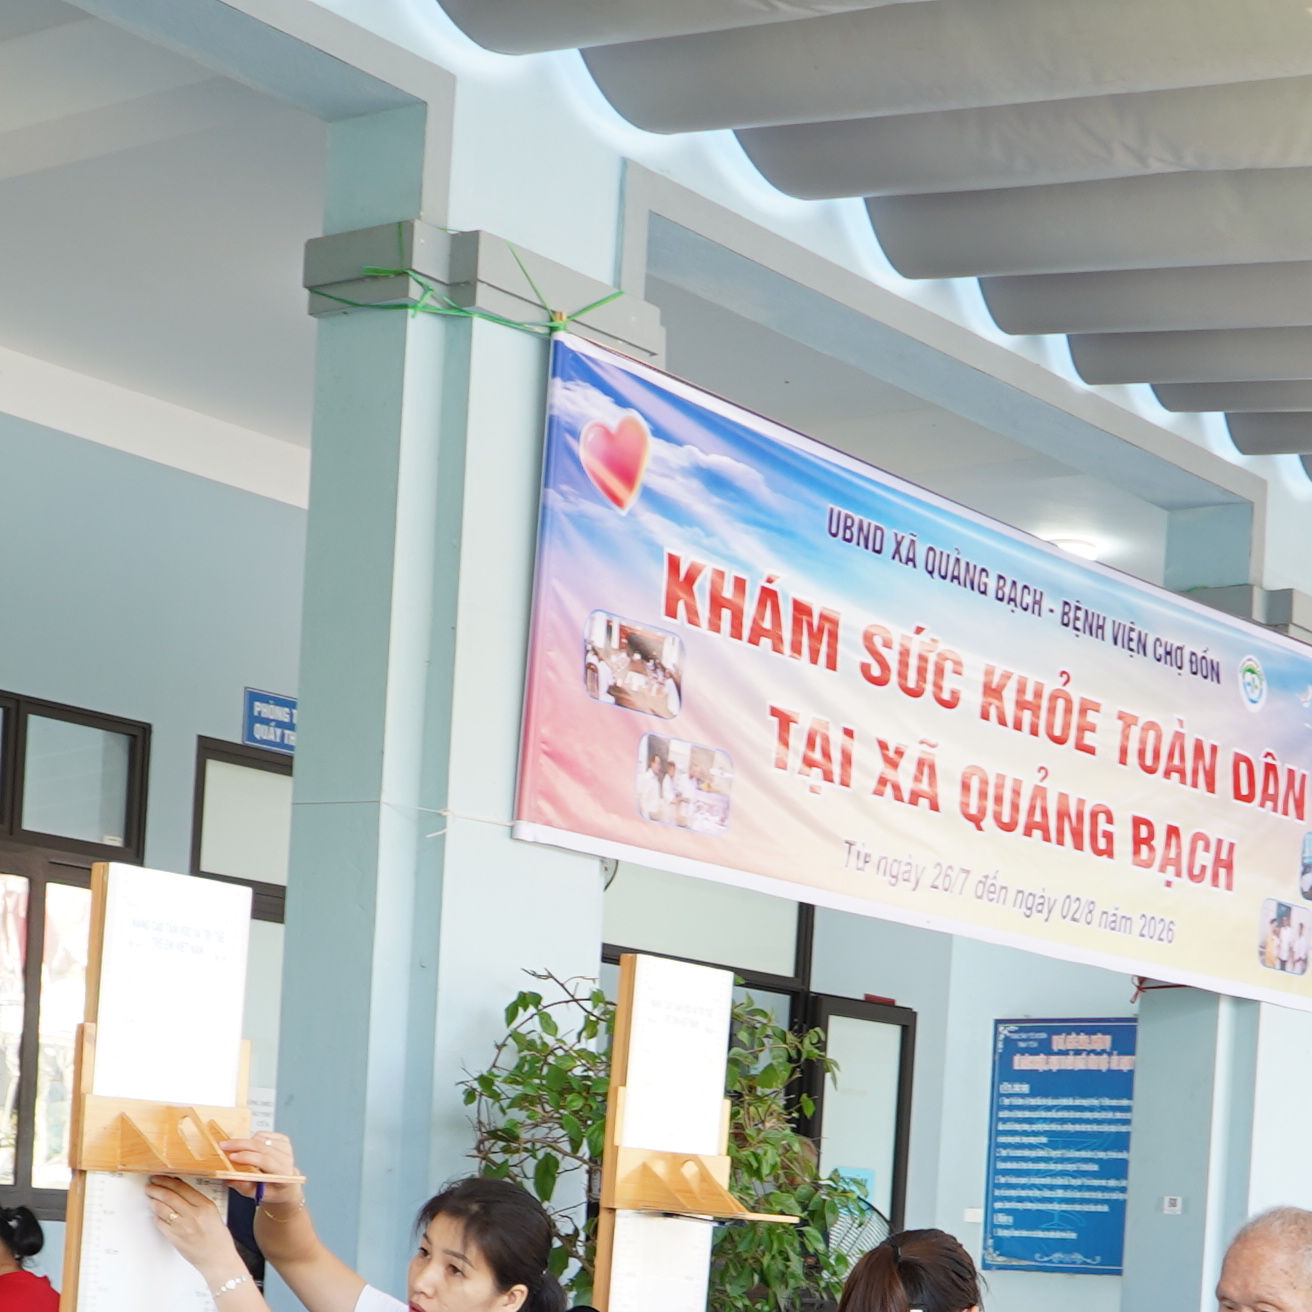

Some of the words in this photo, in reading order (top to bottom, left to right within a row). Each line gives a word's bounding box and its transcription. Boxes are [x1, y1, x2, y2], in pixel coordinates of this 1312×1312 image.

[827, 506, 886, 555] UBND
[891, 532, 918, 569] XÃ
[924, 546, 989, 596] QUẢNG
[995, 573, 1044, 617] BẠCH
[1060, 599, 1106, 642] BỆNH
[1111, 620, 1149, 658] VIỆN
[1153, 636, 1185, 677] CHỢ
[663, 551, 842, 673] KHÁM
[859, 625, 964, 710] SỨC
[980, 669, 1102, 757] KHỎE
[1117, 716, 1221, 795] TOÀN
[1231, 750, 1309, 822] DÂN
[768, 704, 855, 795] TẠI
[872, 736, 940, 815] XÃ
[960, 765, 1116, 861] QUẢNG
[1131, 814, 1237, 892] BẠCH
[876, 854, 926, 892] ngày
[930, 861, 971, 896] 26/7
[975, 869, 1009, 906] đến
[1012, 887, 1058, 923] ngày
[1060, 894, 1096, 926] 02/8
[1098, 906, 1133, 935] năm
[1138, 913, 1176, 944] 2026
